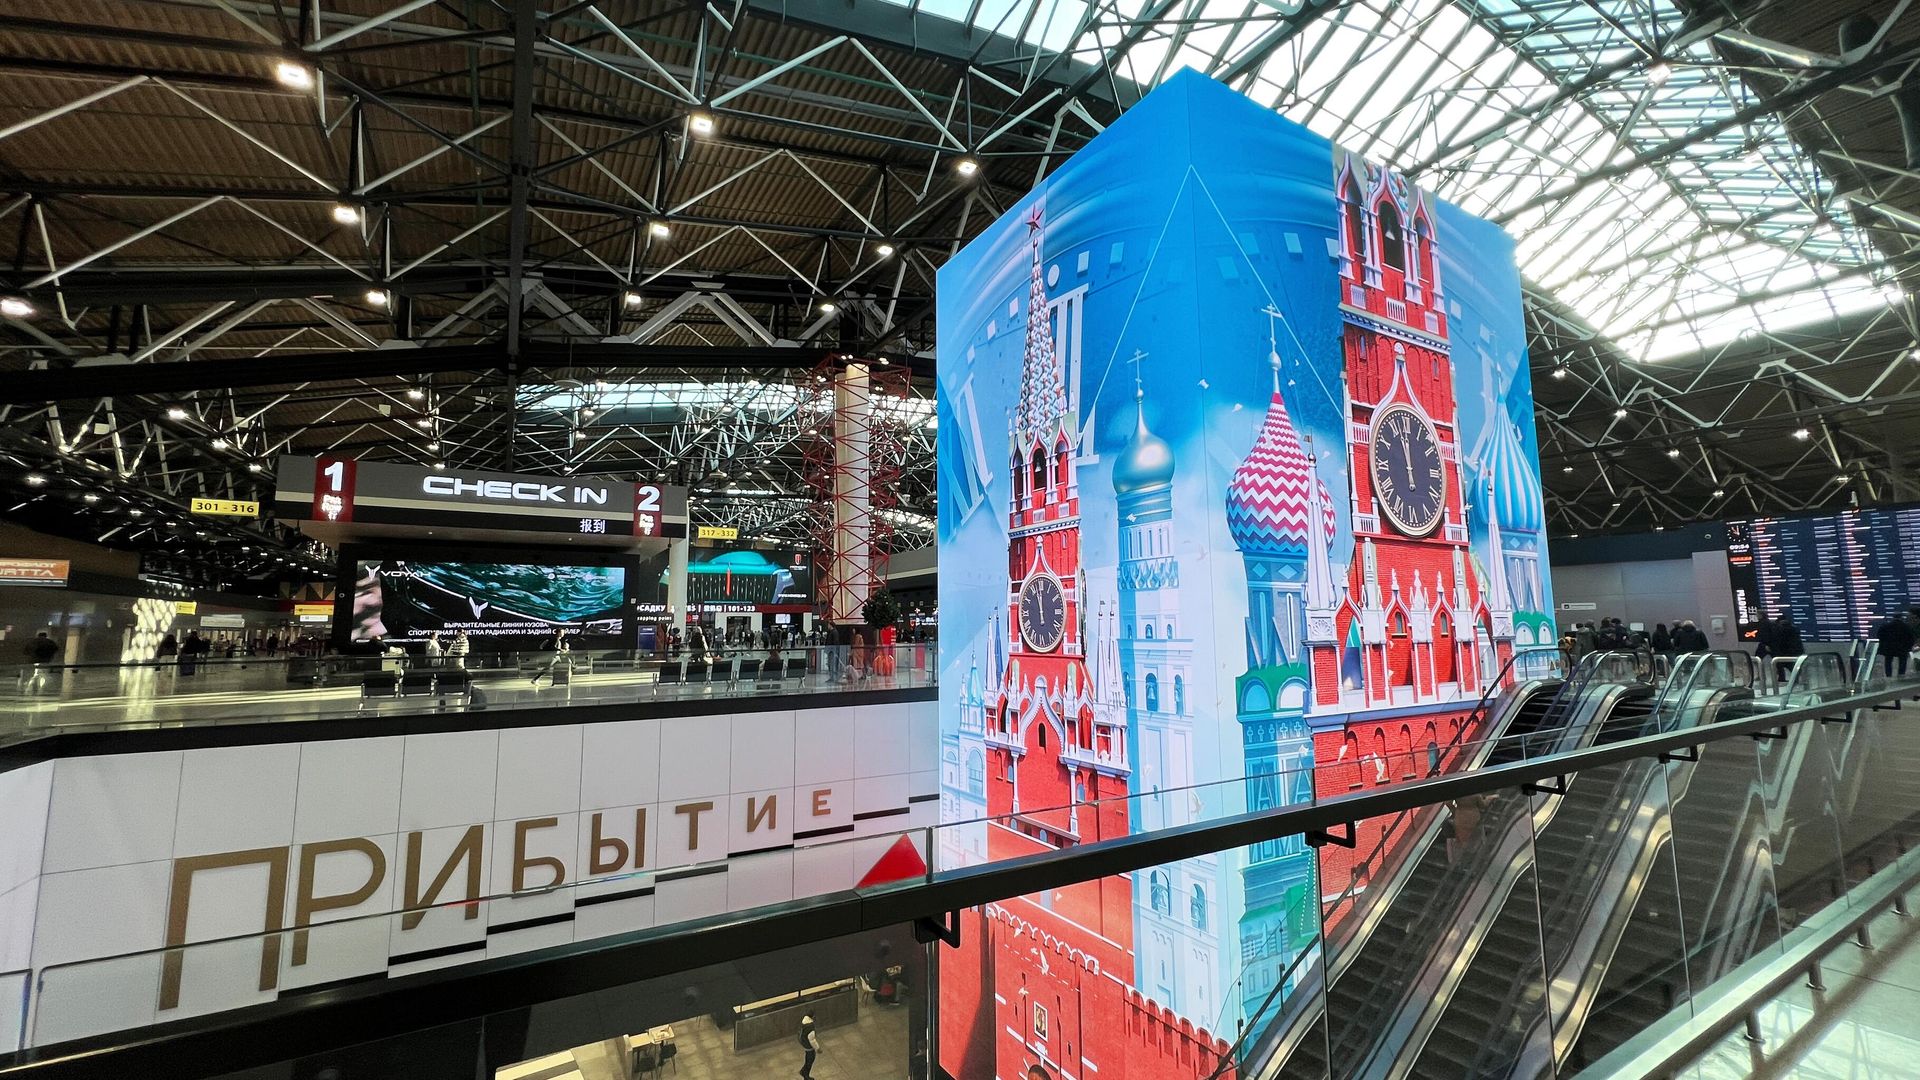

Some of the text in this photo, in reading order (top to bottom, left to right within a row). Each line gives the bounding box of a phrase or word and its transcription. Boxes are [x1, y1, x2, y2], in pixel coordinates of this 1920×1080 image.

[324, 461, 344, 491] 1
[423, 475, 608, 505] CHECK IN
[637, 486, 660, 511] 2
[196, 502, 218, 511] 301
[231, 504, 254, 513] 316
[580, 519, 606, 534] 报到
[381, 570, 432, 578] VOYAH
[158, 787, 832, 1012] ПРИБЫТИЕ
